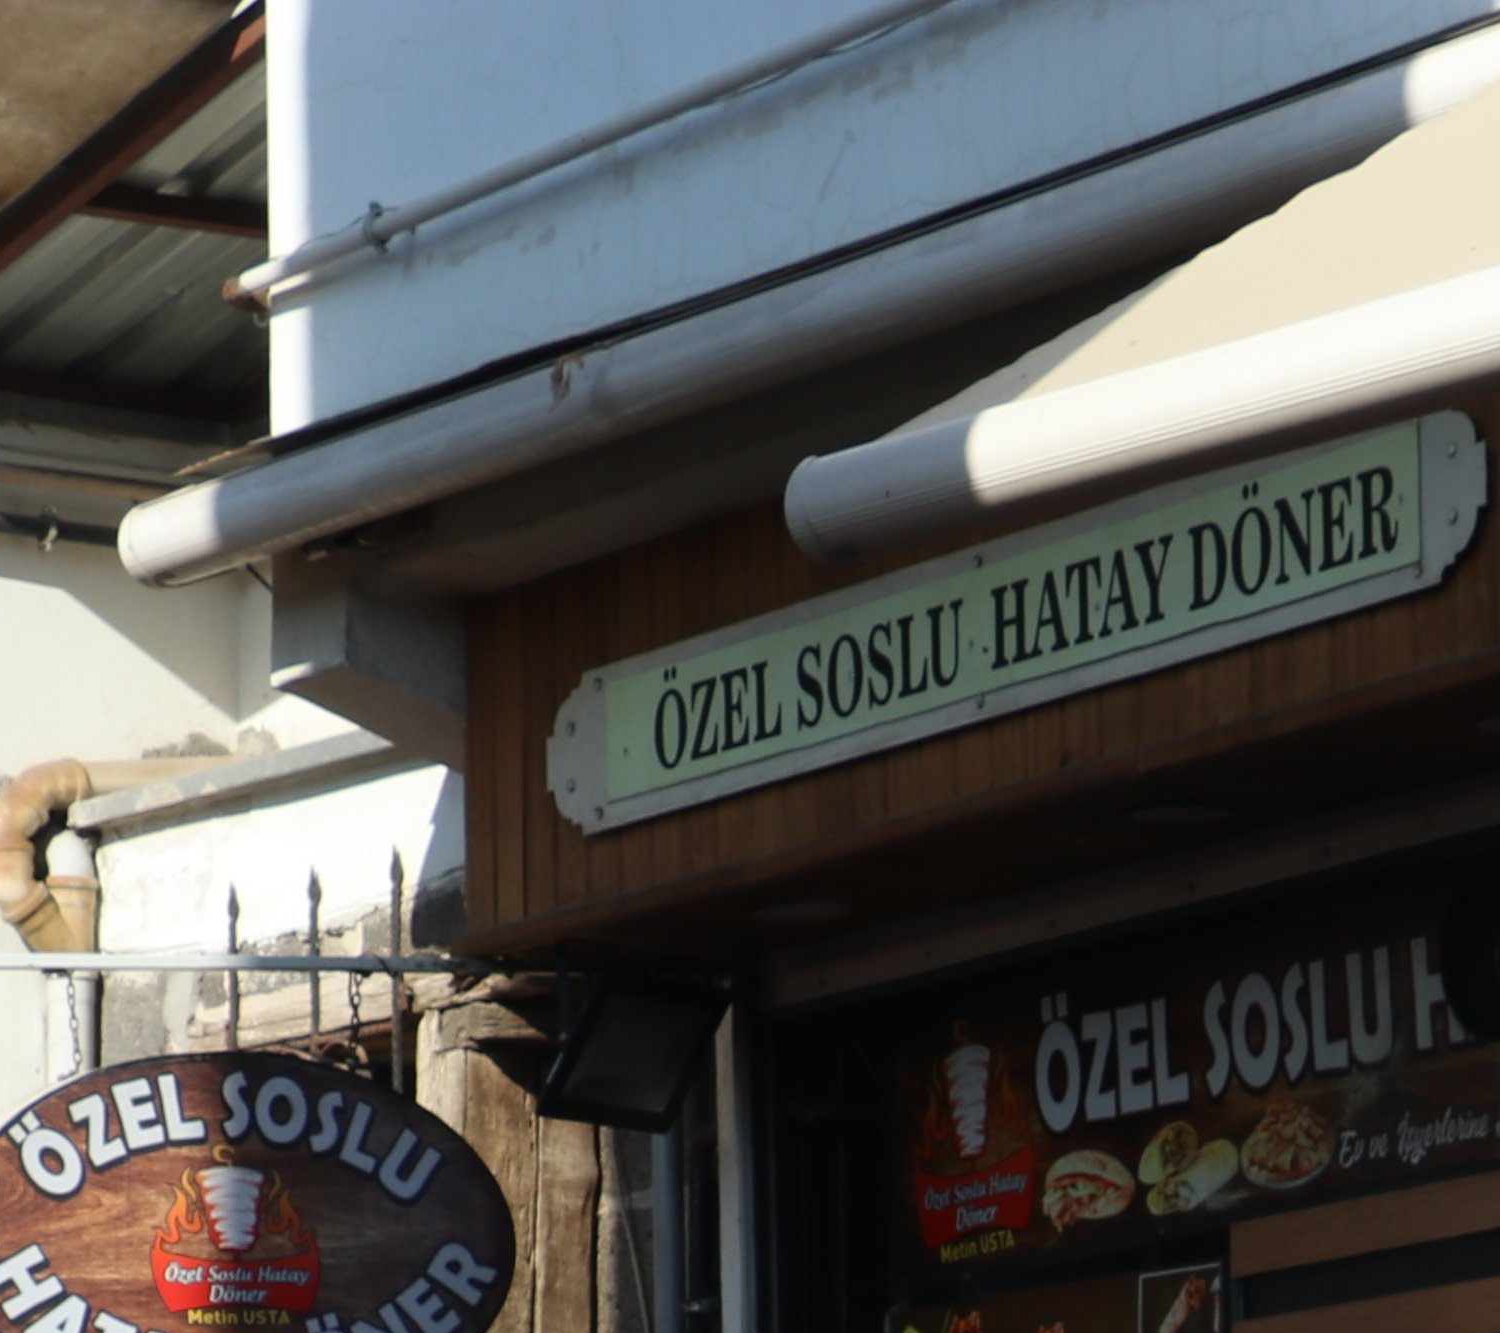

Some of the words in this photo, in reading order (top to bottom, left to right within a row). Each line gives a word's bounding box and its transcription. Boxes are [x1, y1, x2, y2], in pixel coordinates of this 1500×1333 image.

[654, 662, 782, 769] ÖZEL
[795, 599, 964, 730] SOSLU
[990, 535, 1174, 671] HATAY
[1189, 480, 1400, 609] DÖNER
[1035, 990, 1190, 1134] ÖZEL
[1202, 944, 1394, 1099] SOSLU
[7, 1073, 206, 1199] ÖZEL
[220, 1071, 444, 1202] SOSLU
[980, 1228, 1015, 1254] USTA
[164, 1261, 203, 1285] Özel
[207, 1265, 252, 1283] Soslu
[257, 1265, 309, 1286] Hatay
[209, 1284, 268, 1303] Döner
[187, 1309, 238, 1325] Metin
[243, 1309, 291, 1325] USTA
